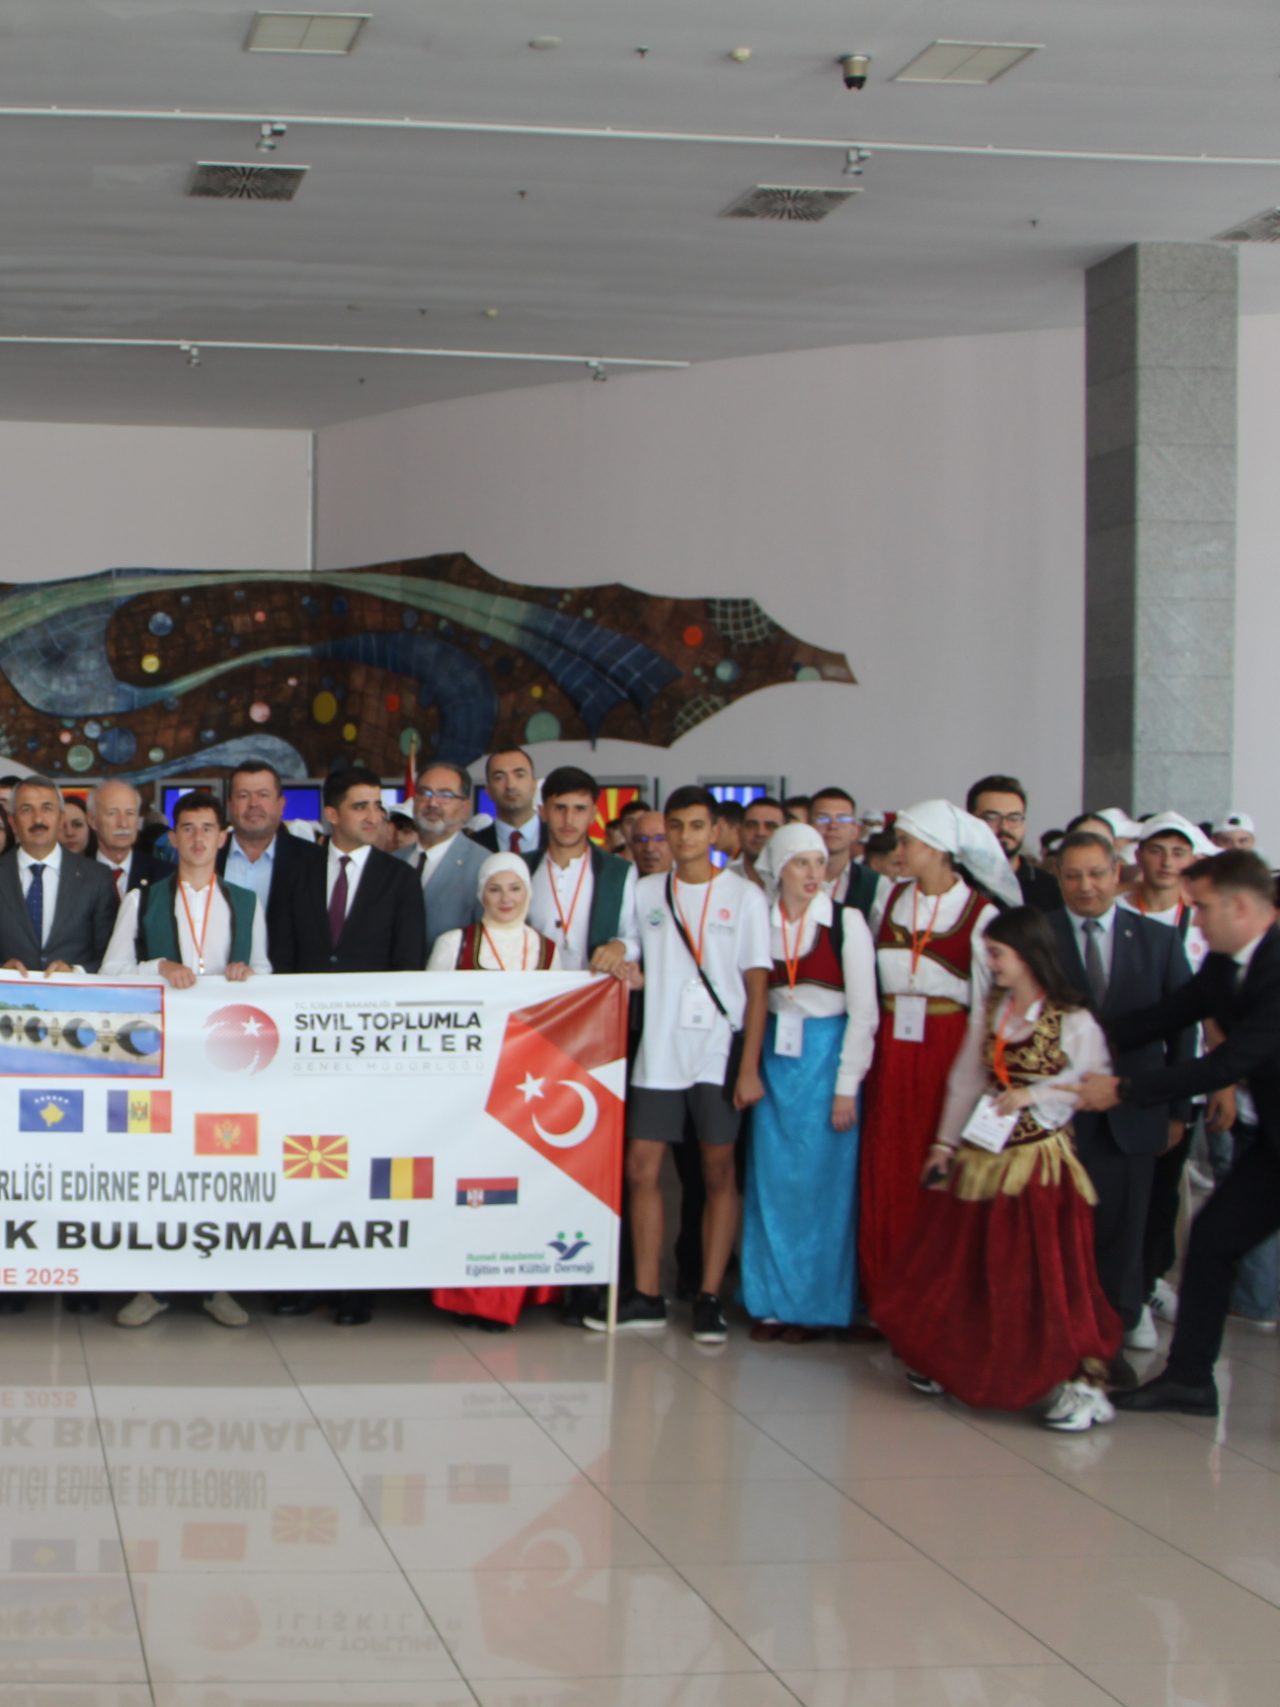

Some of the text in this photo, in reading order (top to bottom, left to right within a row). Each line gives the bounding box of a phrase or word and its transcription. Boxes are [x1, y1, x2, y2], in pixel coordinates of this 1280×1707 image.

[357, 1012, 482, 1030] TOPLUMLA
[60, 1163, 139, 1202] EDİRNE
[147, 1171, 276, 1203] PLATFORMU
[57, 1219, 410, 1260] BULUŞMALARI
[26, 1267, 80, 1286] 2025
[465, 1261, 595, 1277] Eğitim ve Kültür Derneği
